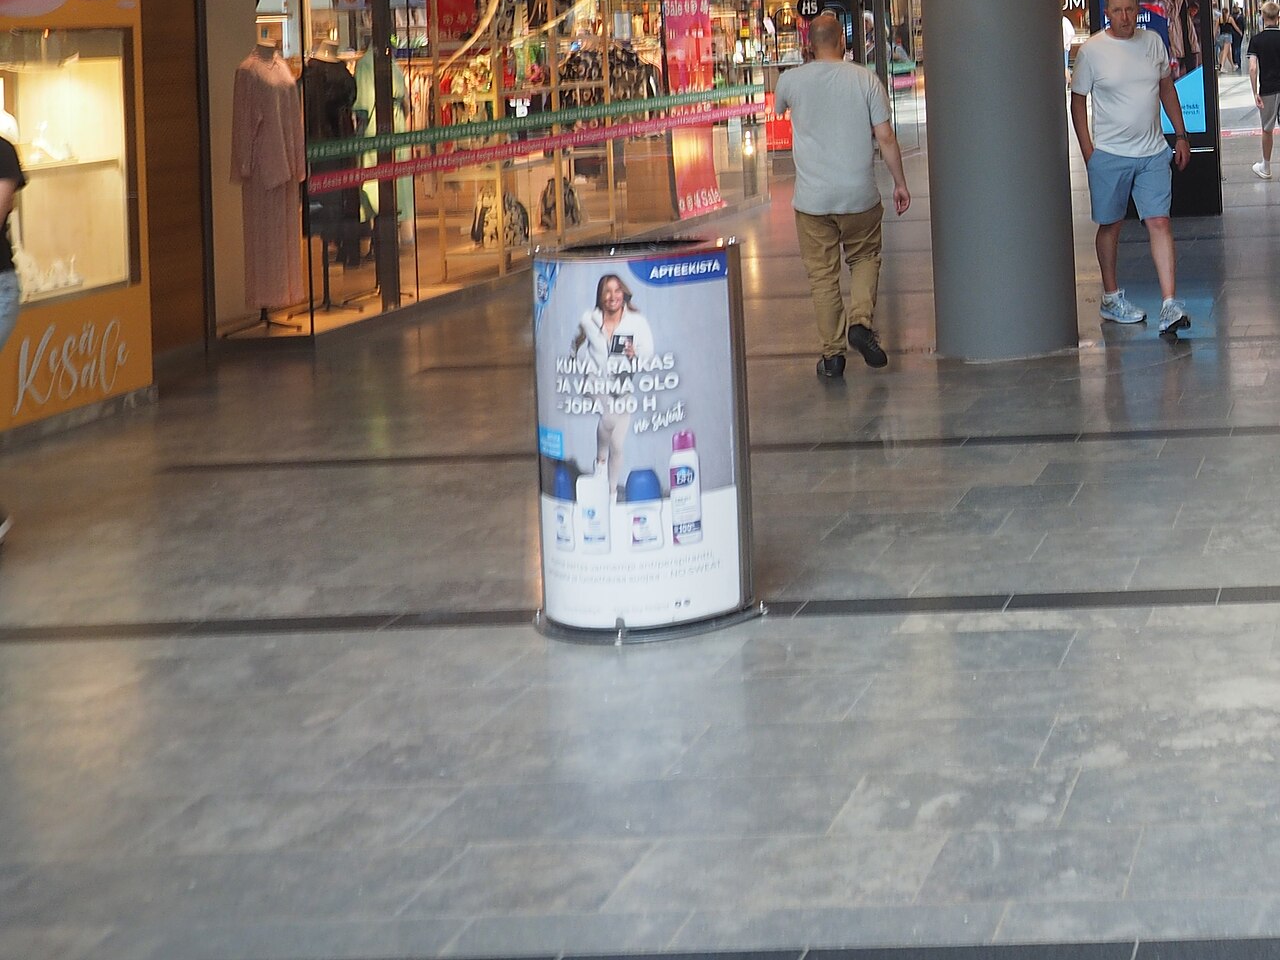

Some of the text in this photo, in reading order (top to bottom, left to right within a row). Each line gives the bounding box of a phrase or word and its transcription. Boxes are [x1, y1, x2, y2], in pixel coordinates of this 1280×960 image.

[664, 0, 682, 16] Sale
[701, 188, 721, 206] Sale
[650, 259, 721, 279] APTEEKISTA
[556, 352, 675, 375] KUIVA, RAIKAS
[557, 372, 680, 394] JA VARMA OLO
[608, 396, 638, 415] 100
[643, 394, 657, 411] H
